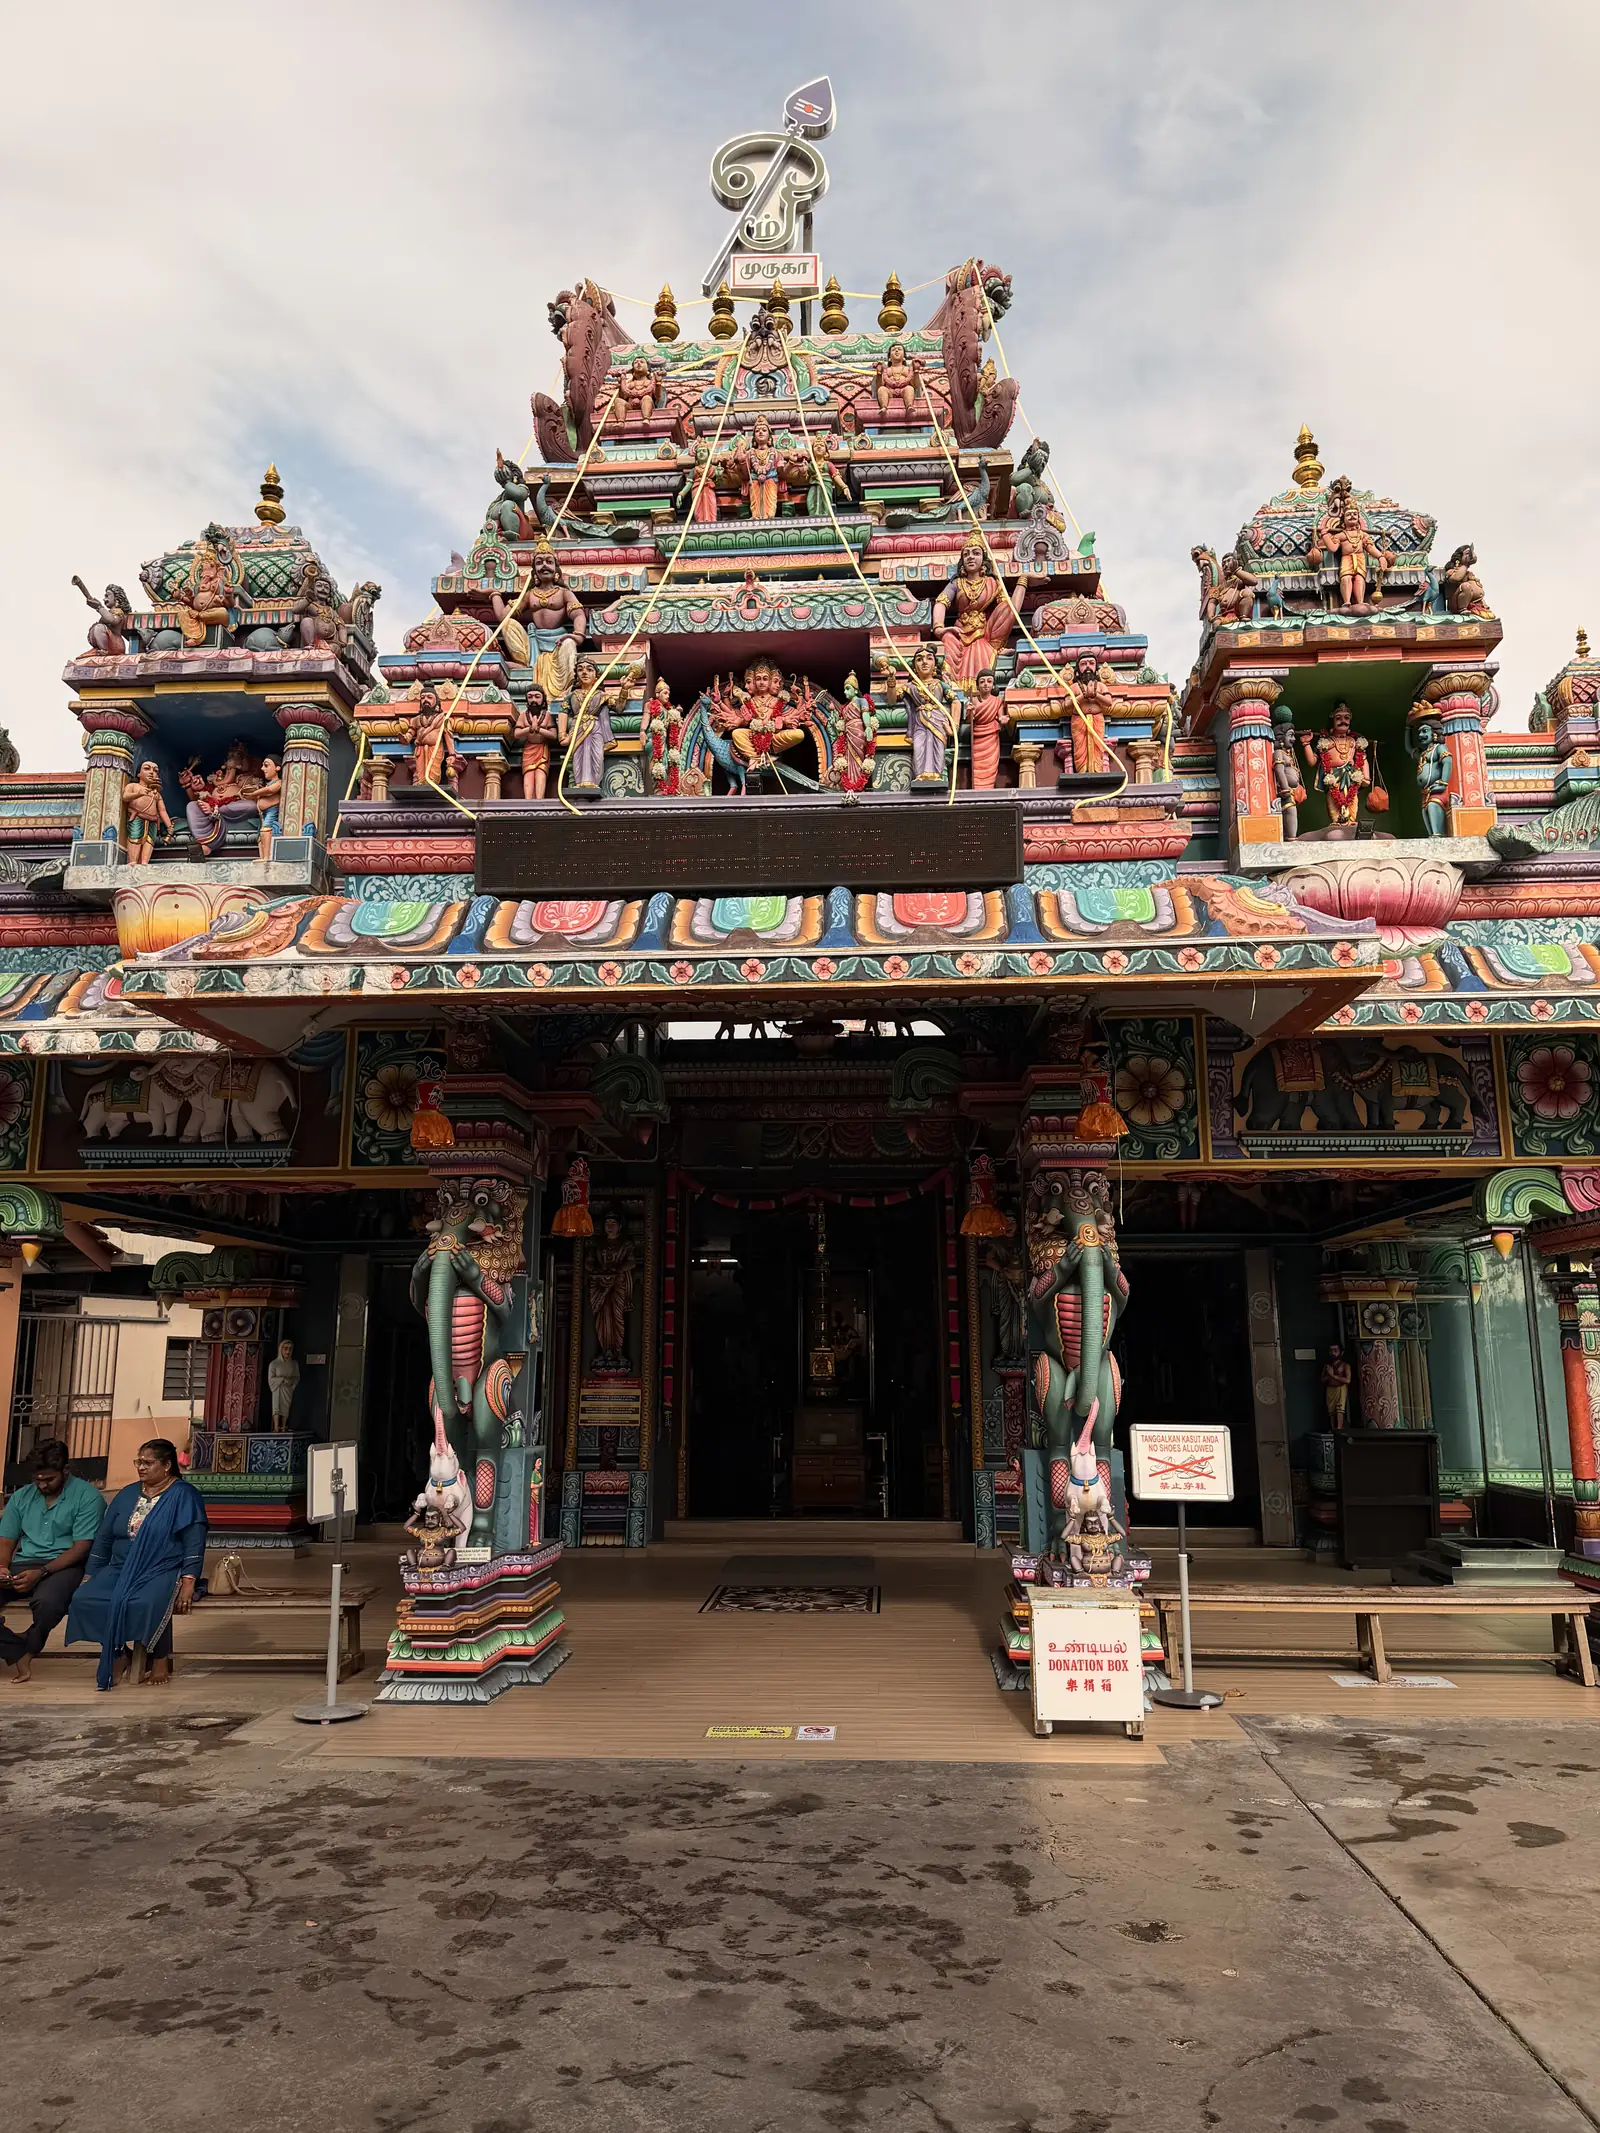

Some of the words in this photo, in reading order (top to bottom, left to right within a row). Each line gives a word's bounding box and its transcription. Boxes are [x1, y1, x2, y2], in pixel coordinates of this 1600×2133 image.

[740, 261, 811, 280] முருகா
[1141, 1434, 1181, 1444] TANGGALKAN
[1181, 1435, 1201, 1444] KASUT
[1202, 1435, 1219, 1444] ANDA
[1148, 1444, 1158, 1453] NO
[1159, 1444, 1181, 1453] SHOES
[1182, 1444, 1214, 1453] ALLOWED
[1160, 1482, 1206, 1491] 禁止穿鞋
[1048, 1640, 1127, 1656] உண்டியல்
[1048, 1659, 1104, 1672] DONATION
[1107, 1659, 1129, 1672] BOX
